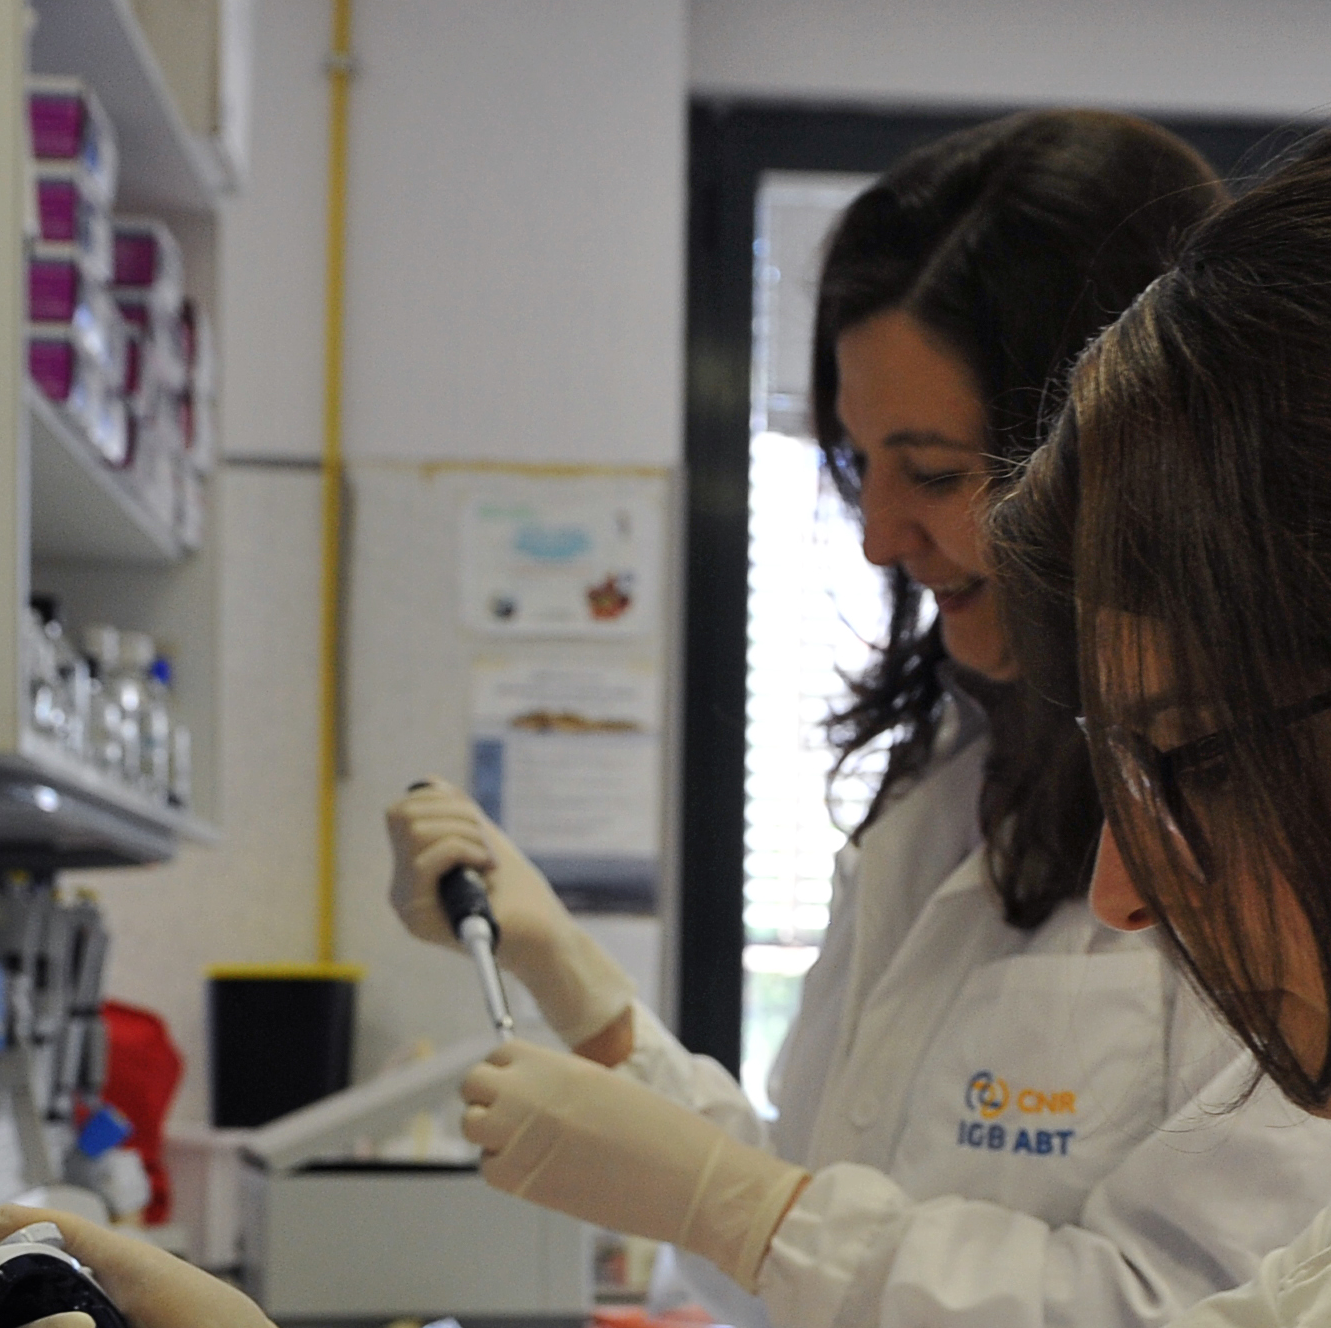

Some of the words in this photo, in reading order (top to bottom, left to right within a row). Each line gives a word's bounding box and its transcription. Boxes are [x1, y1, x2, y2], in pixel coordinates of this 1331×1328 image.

[1017, 1088, 1076, 1115] CNR
[957, 1119, 1006, 1150] IGB
[1012, 1128, 1075, 1157] ABT
